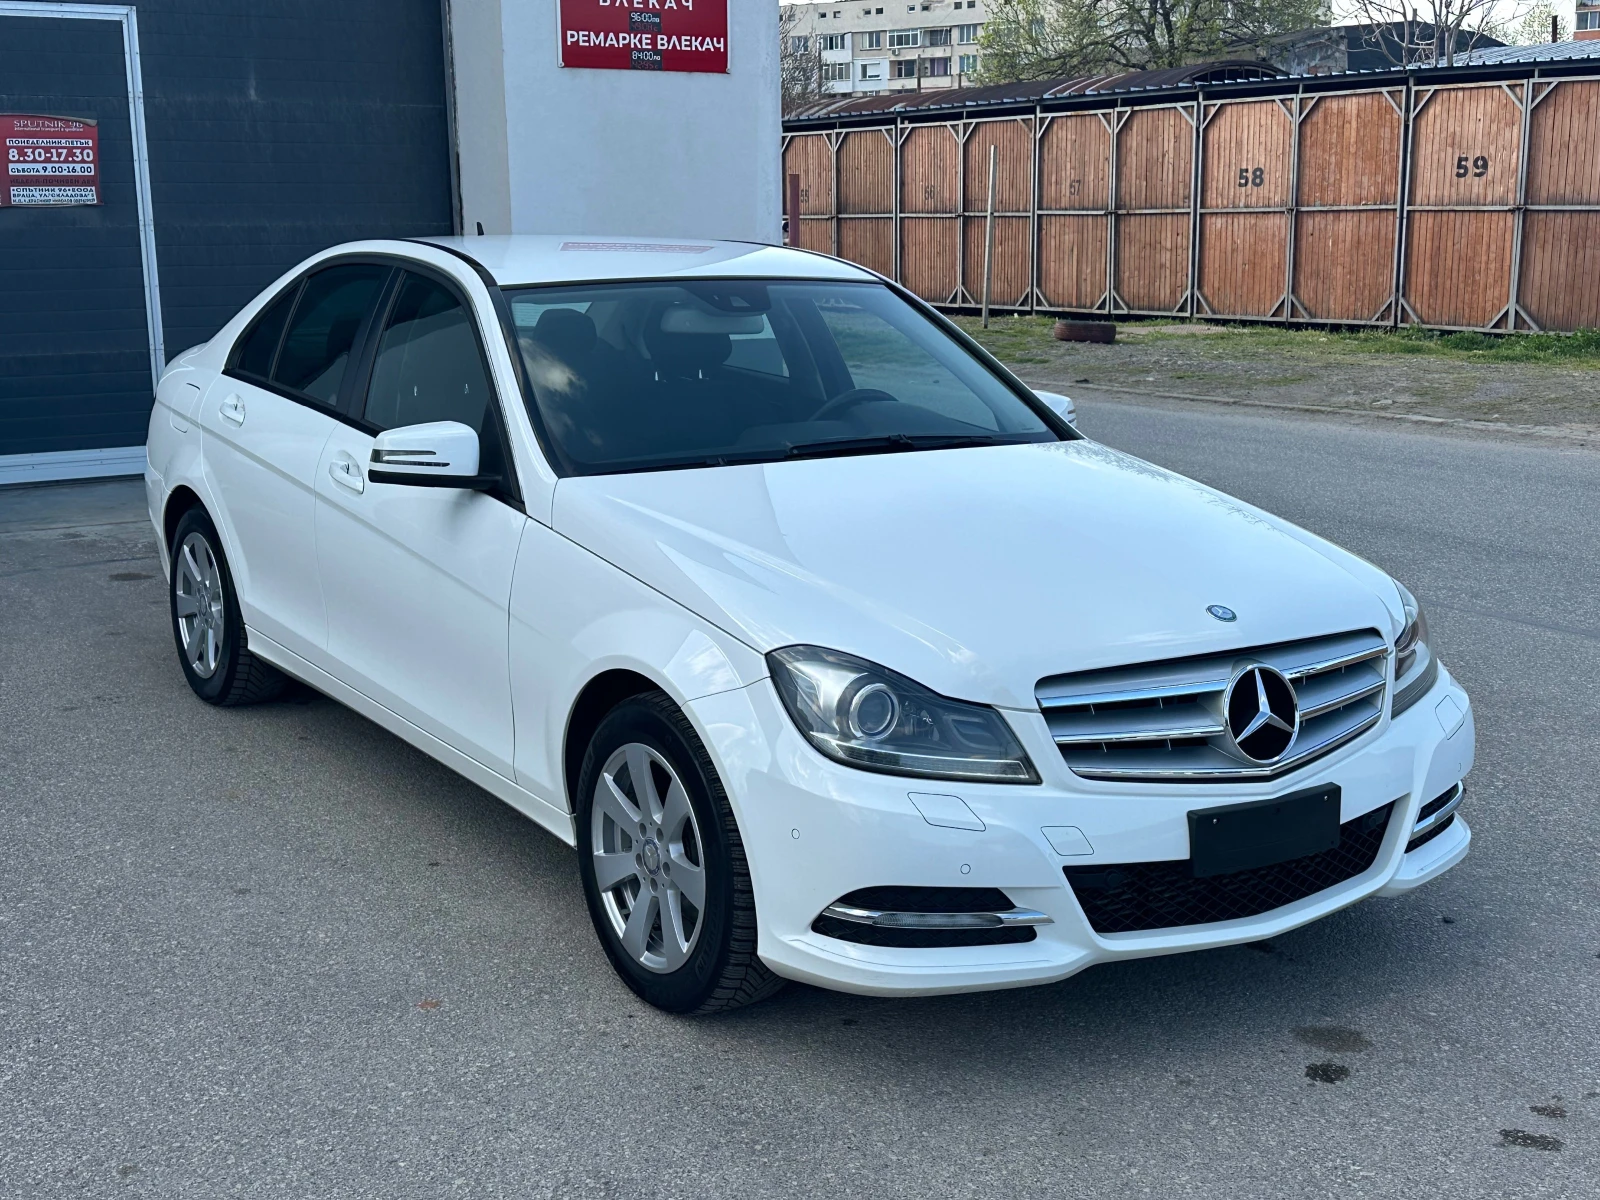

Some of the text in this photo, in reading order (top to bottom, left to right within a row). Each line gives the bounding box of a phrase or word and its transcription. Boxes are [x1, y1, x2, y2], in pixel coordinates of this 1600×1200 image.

[566, 30, 725, 52] РЕМАРКЕ ВЛЕКАЧ
[14, 119, 66, 128] SPUTNIK
[8, 148, 94, 161] 8.30-17.30
[41, 165, 92, 174] 9.00-16.00
[1455, 155, 1489, 178] 59
[1237, 166, 1265, 188] 58
[1069, 179, 1082, 197] 57
